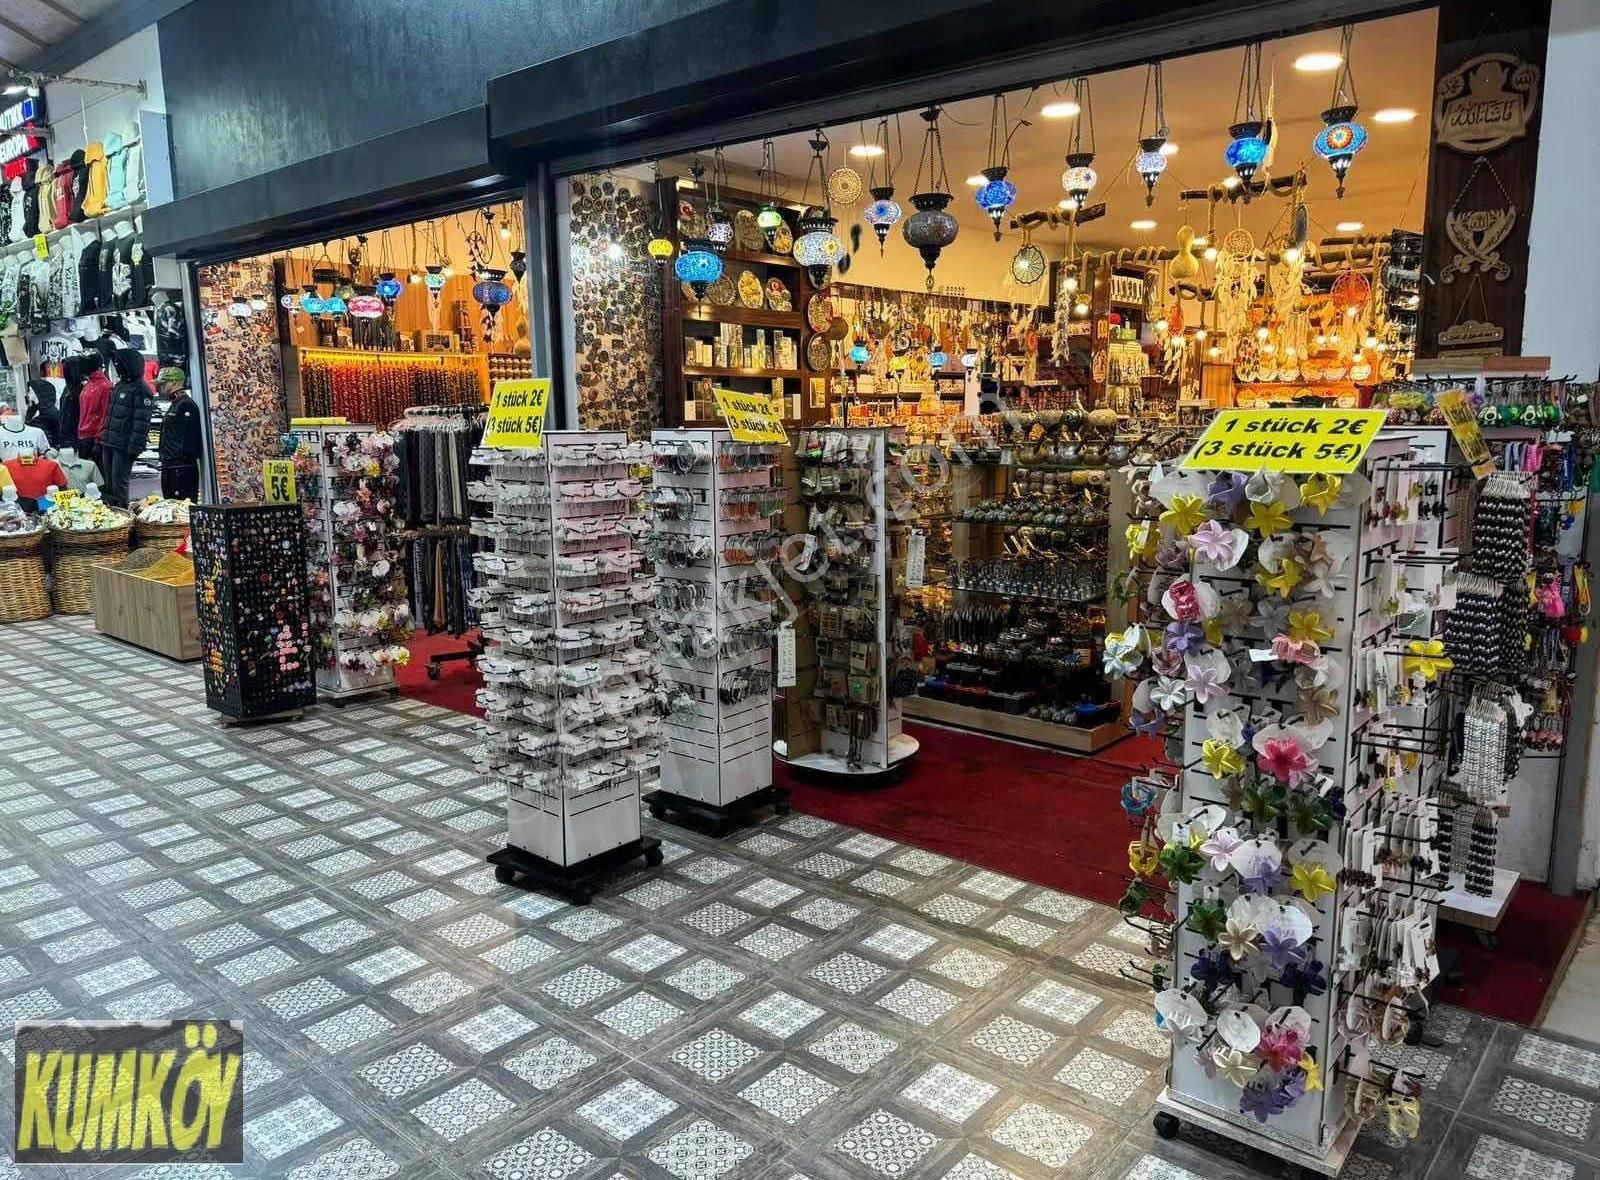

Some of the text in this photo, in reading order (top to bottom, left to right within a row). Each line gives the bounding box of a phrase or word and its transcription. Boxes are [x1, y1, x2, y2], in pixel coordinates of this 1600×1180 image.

[496, 388, 544, 408] 1 stück 2€
[722, 397, 731, 409] 1
[731, 399, 760, 414] stück
[486, 415, 542, 438] (3 stück 5€)
[727, 415, 739, 432] (3
[741, 418, 769, 433] stück
[1224, 416, 1369, 436] 1 stück 2€
[1193, 440, 1362, 464] (3 stück 5€)
[271, 475, 290, 502] 5€
